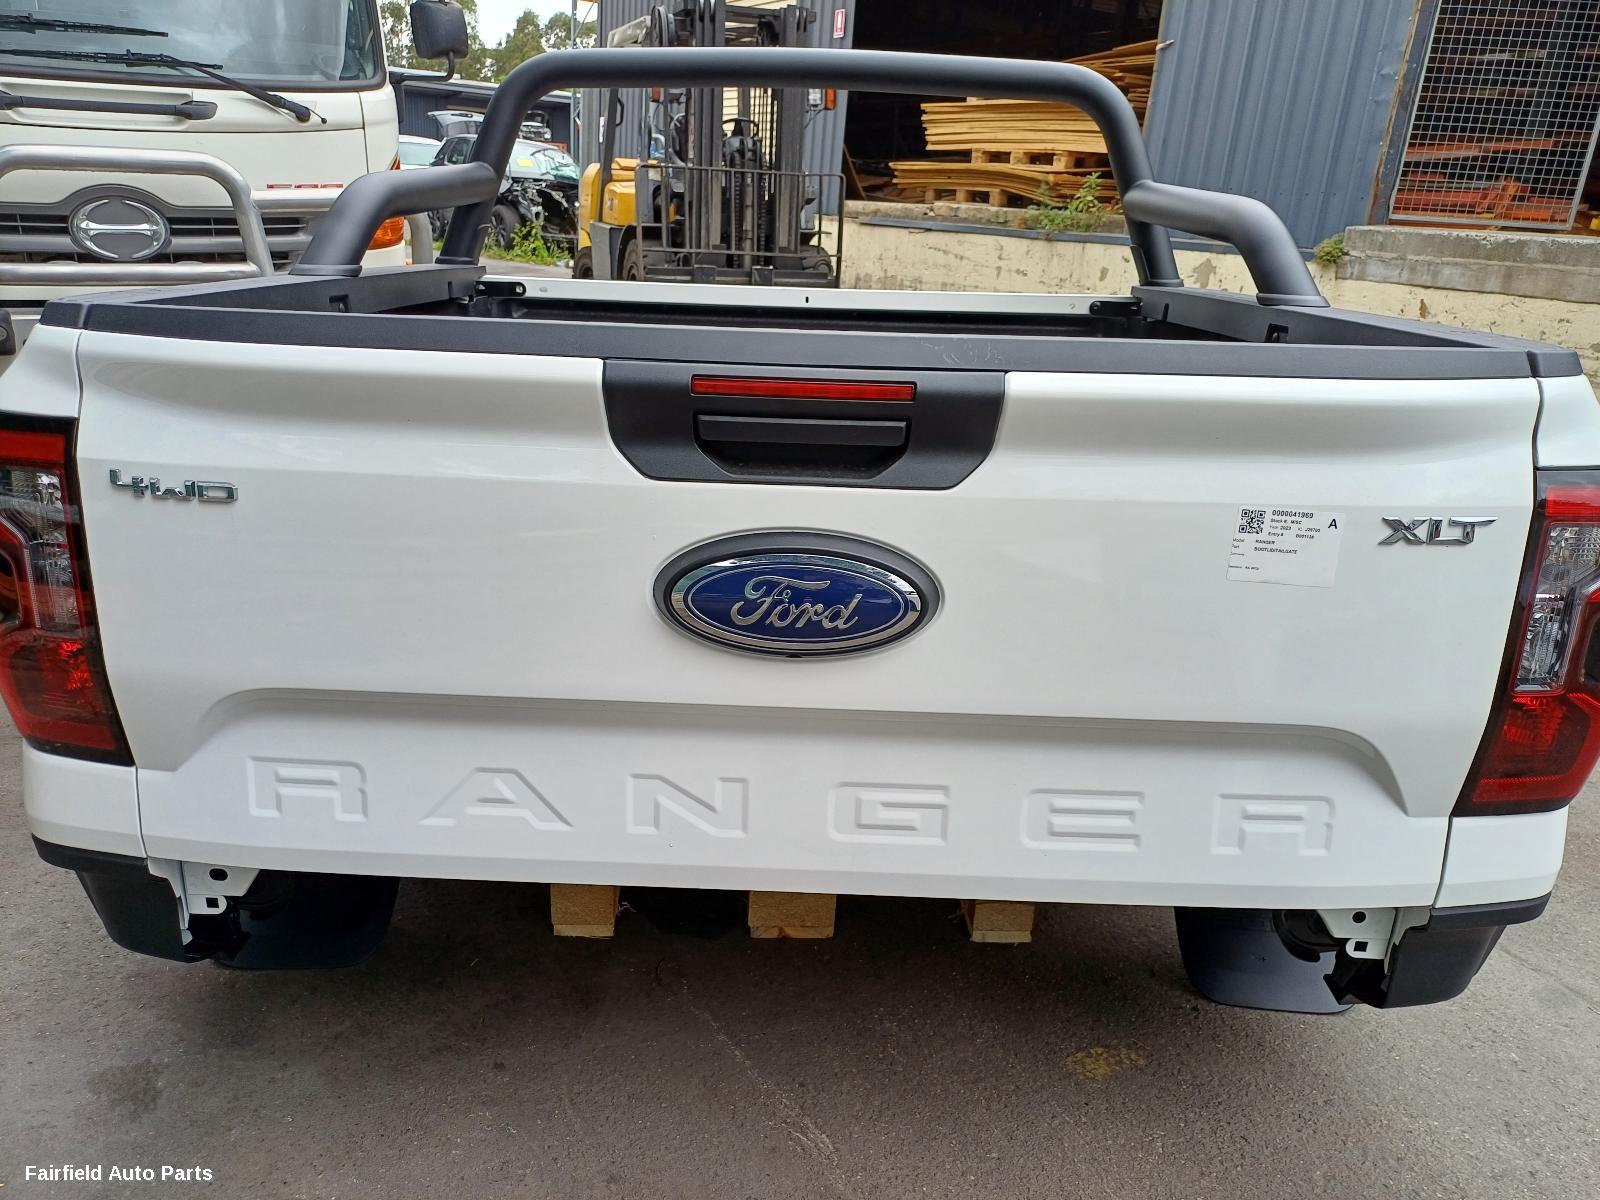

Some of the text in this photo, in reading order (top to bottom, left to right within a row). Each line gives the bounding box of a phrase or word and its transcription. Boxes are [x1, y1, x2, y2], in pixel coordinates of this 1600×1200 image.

[109, 468, 238, 502] 4WD
[1328, 518, 1337, 529] A
[1378, 516, 1497, 545] XLT
[730, 575, 863, 630] Ford
[246, 755, 1335, 856] RANGER
